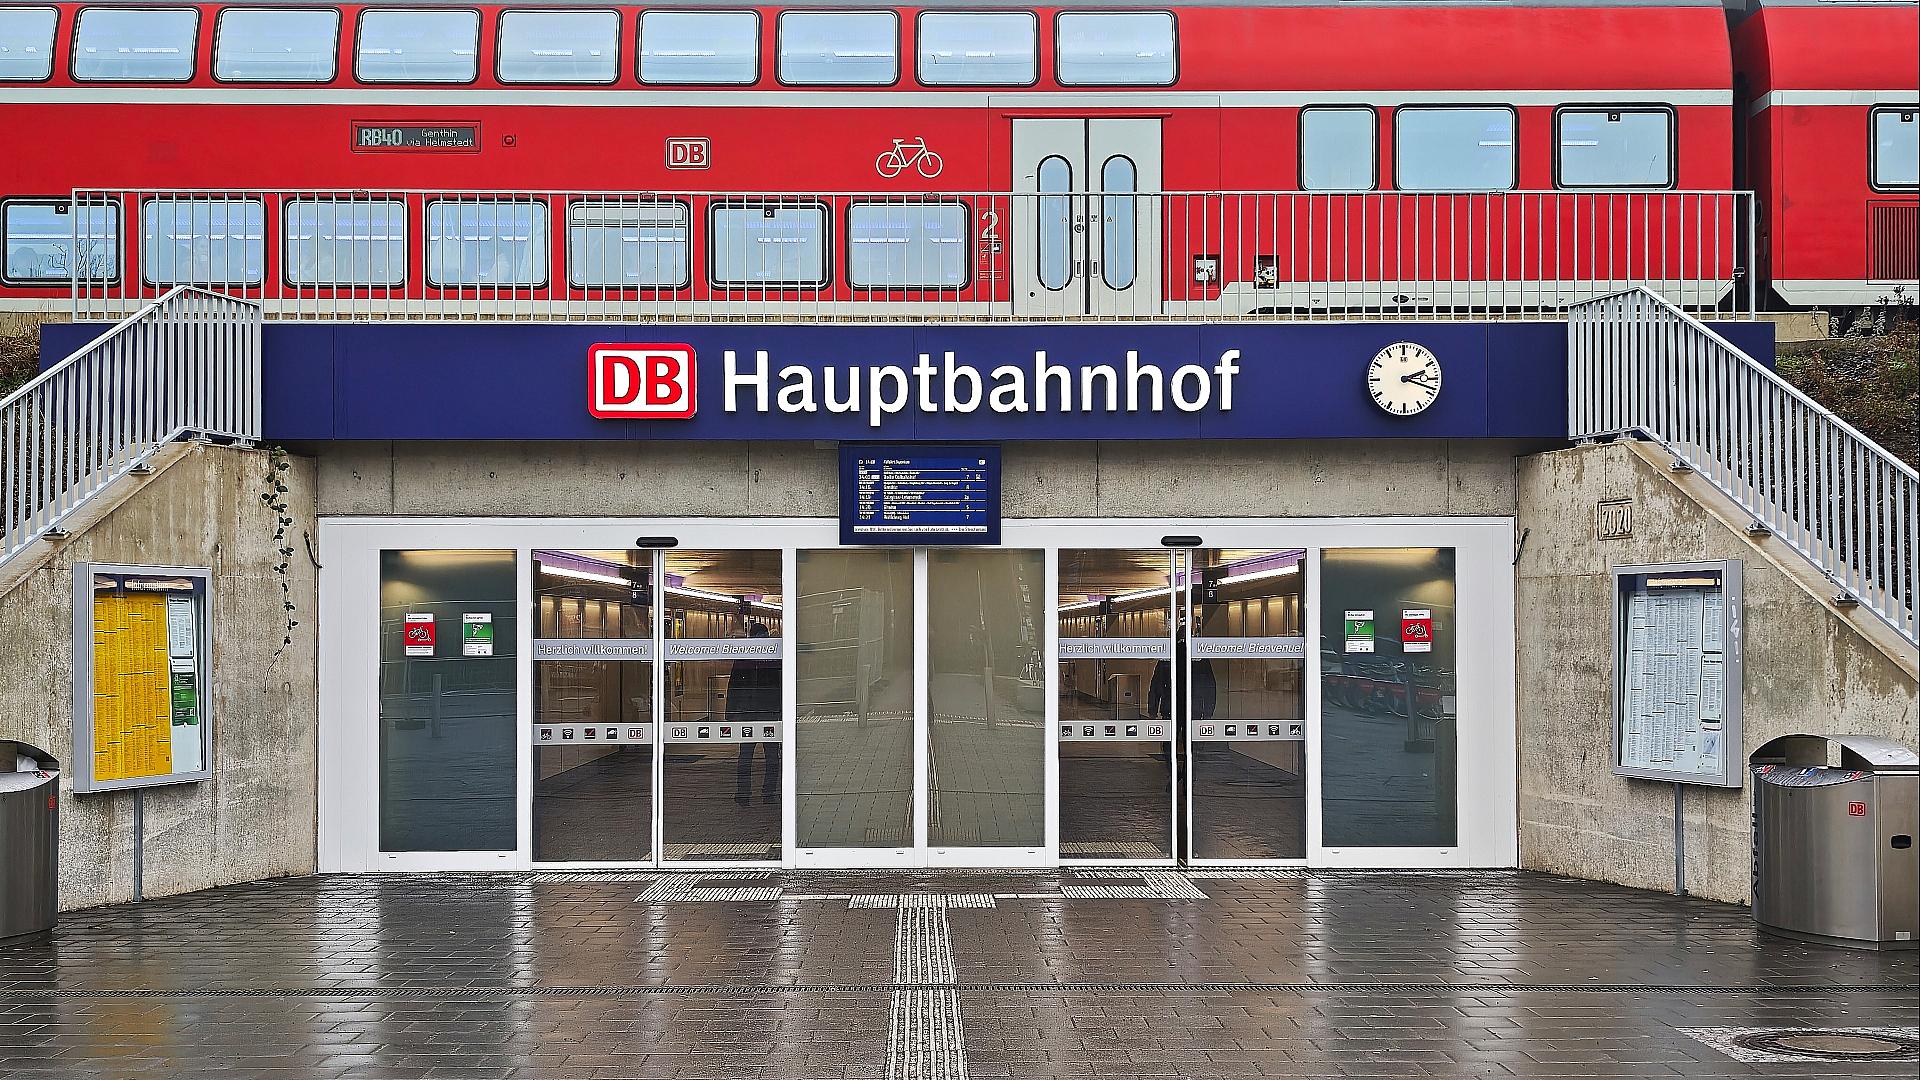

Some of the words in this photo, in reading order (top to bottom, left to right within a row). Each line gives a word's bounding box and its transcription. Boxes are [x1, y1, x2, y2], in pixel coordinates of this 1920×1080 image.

[361, 128, 403, 146] RB40
[421, 128, 458, 138] Genthin
[406, 138, 421, 147] via
[425, 137, 474, 147] Helmstedt
[672, 143, 705, 163] DB
[981, 211, 999, 239] 2
[602, 355, 683, 405] DB
[723, 349, 1241, 427] Hauptbahnhof
[1602, 505, 1632, 536] 2020
[537, 644, 580, 655] Herzlich
[582, 644, 648, 655] willkommen!
[669, 644, 720, 654] Welcome!
[721, 643, 778, 654] Bienvenue!
[1059, 643, 1100, 654] Herzlich
[1102, 643, 1167, 654] willkommen!
[1197, 643, 1246, 653] Welcome!
[1248, 642, 1304, 653] Bienvenue!
[629, 729, 642, 738] DB
[674, 728, 686, 737] DB
[1149, 726, 1162, 735] DB
[1201, 726, 1213, 735] DB
[1850, 803, 1864, 815] DB
